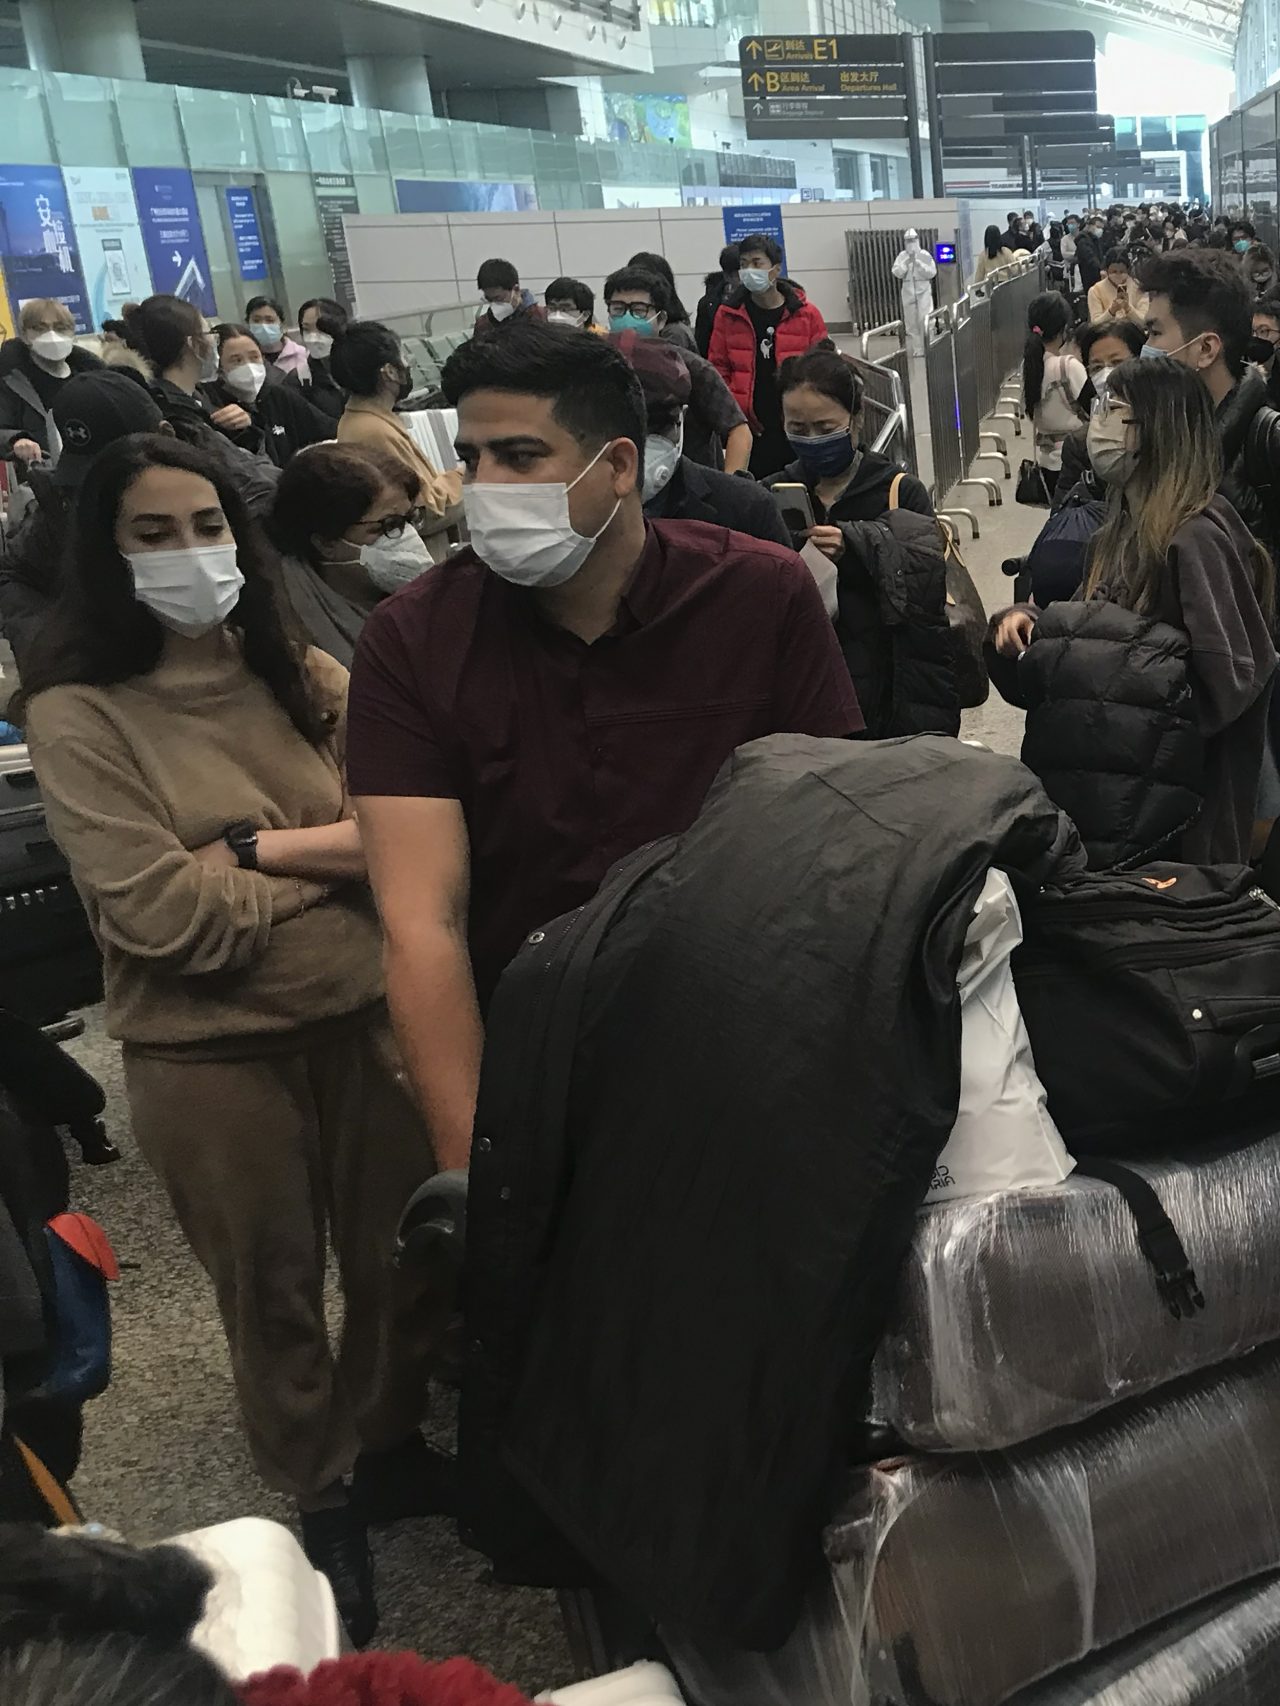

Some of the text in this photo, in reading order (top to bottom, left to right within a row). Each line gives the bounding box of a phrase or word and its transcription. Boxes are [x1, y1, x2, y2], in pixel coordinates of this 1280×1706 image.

[813, 38, 838, 60] E1
[766, 71, 780, 92] B
[840, 71, 880, 82] 出发大厅
[840, 83, 882, 93] Departures
